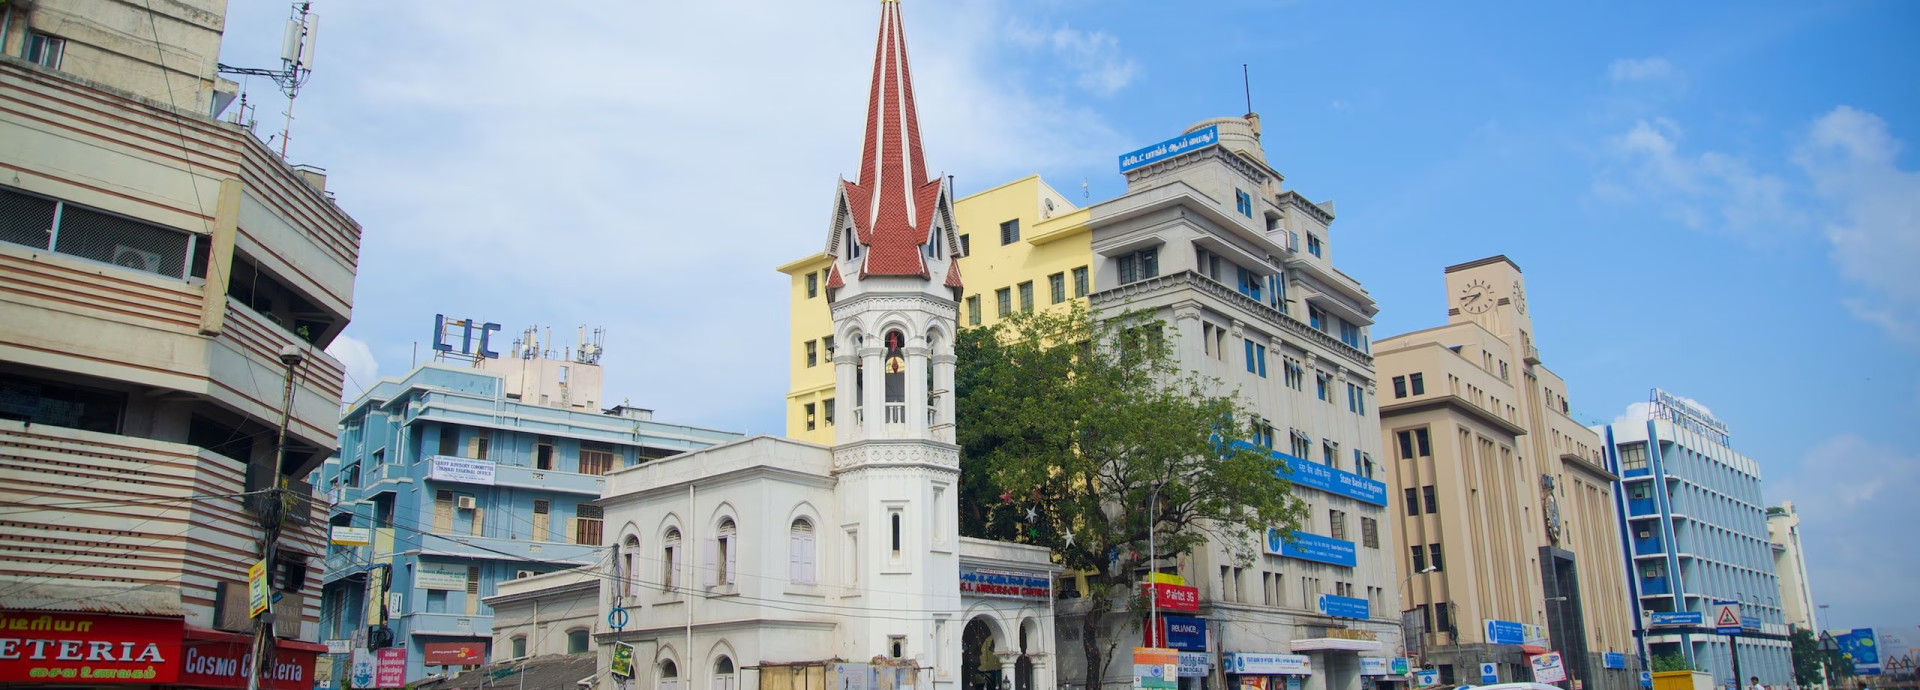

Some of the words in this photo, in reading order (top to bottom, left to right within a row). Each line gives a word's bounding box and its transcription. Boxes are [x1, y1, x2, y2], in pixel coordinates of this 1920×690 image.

[432, 313, 501, 359] LIC
[1339, 473, 1351, 486] State
[1351, 476, 1362, 488] Bank
[1368, 481, 1383, 495] Mysore
[975, 583, 1019, 595] ANDERSON
[1171, 589, 1185, 601] airtel
[1186, 590, 1195, 602] 3G
[0, 638, 165, 662] ETERIA
[29, 666, 78, 679] சைவ
[80, 665, 156, 679] உணவகம்
